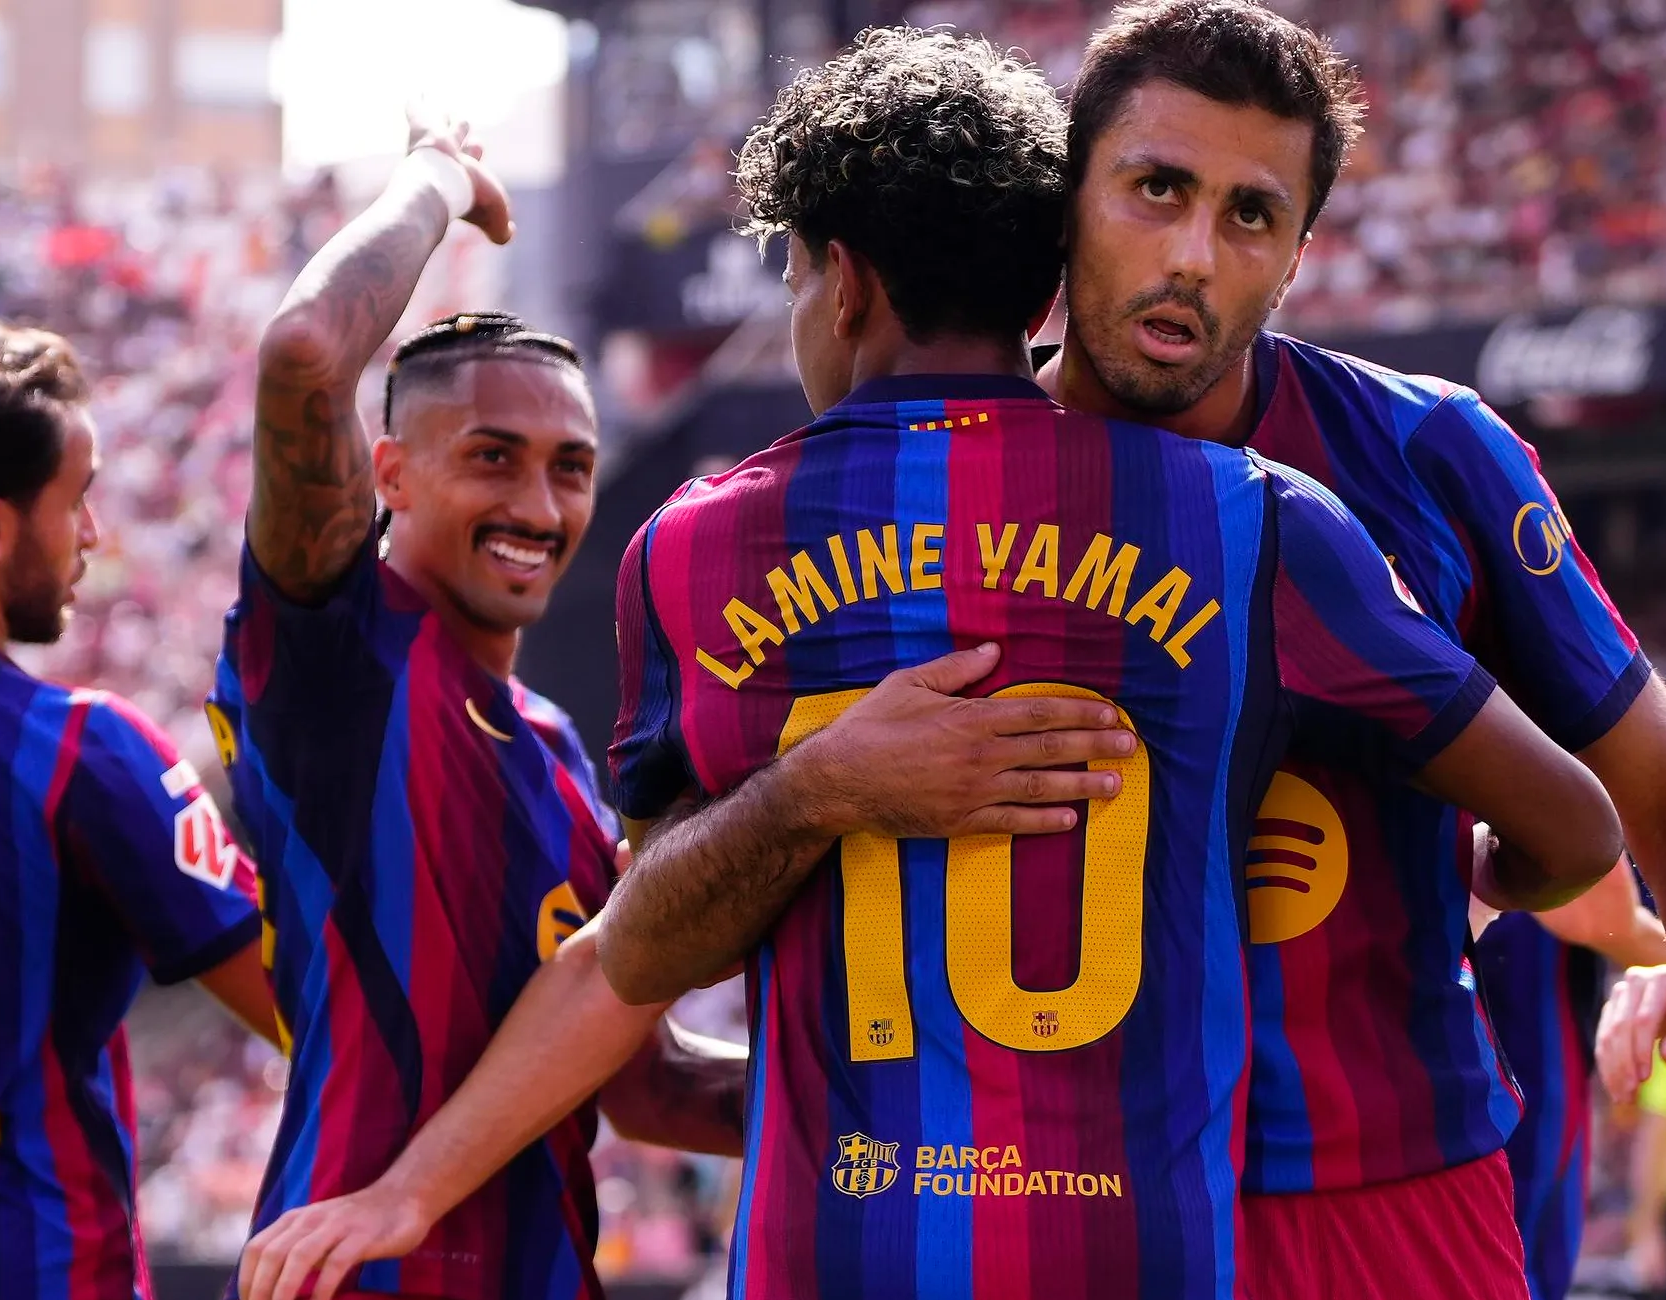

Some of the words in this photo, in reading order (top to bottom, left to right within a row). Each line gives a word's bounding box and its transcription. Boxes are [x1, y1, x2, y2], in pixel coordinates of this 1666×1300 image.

[695, 522, 947, 690] LAMINE
[975, 522, 1221, 670] YAMAL
[778, 682, 1150, 1062] 10
[853, 1159, 878, 1168] FCB
[915, 1144, 1023, 1174] BARÇA
[913, 1170, 1123, 1197] FOUNDATION
